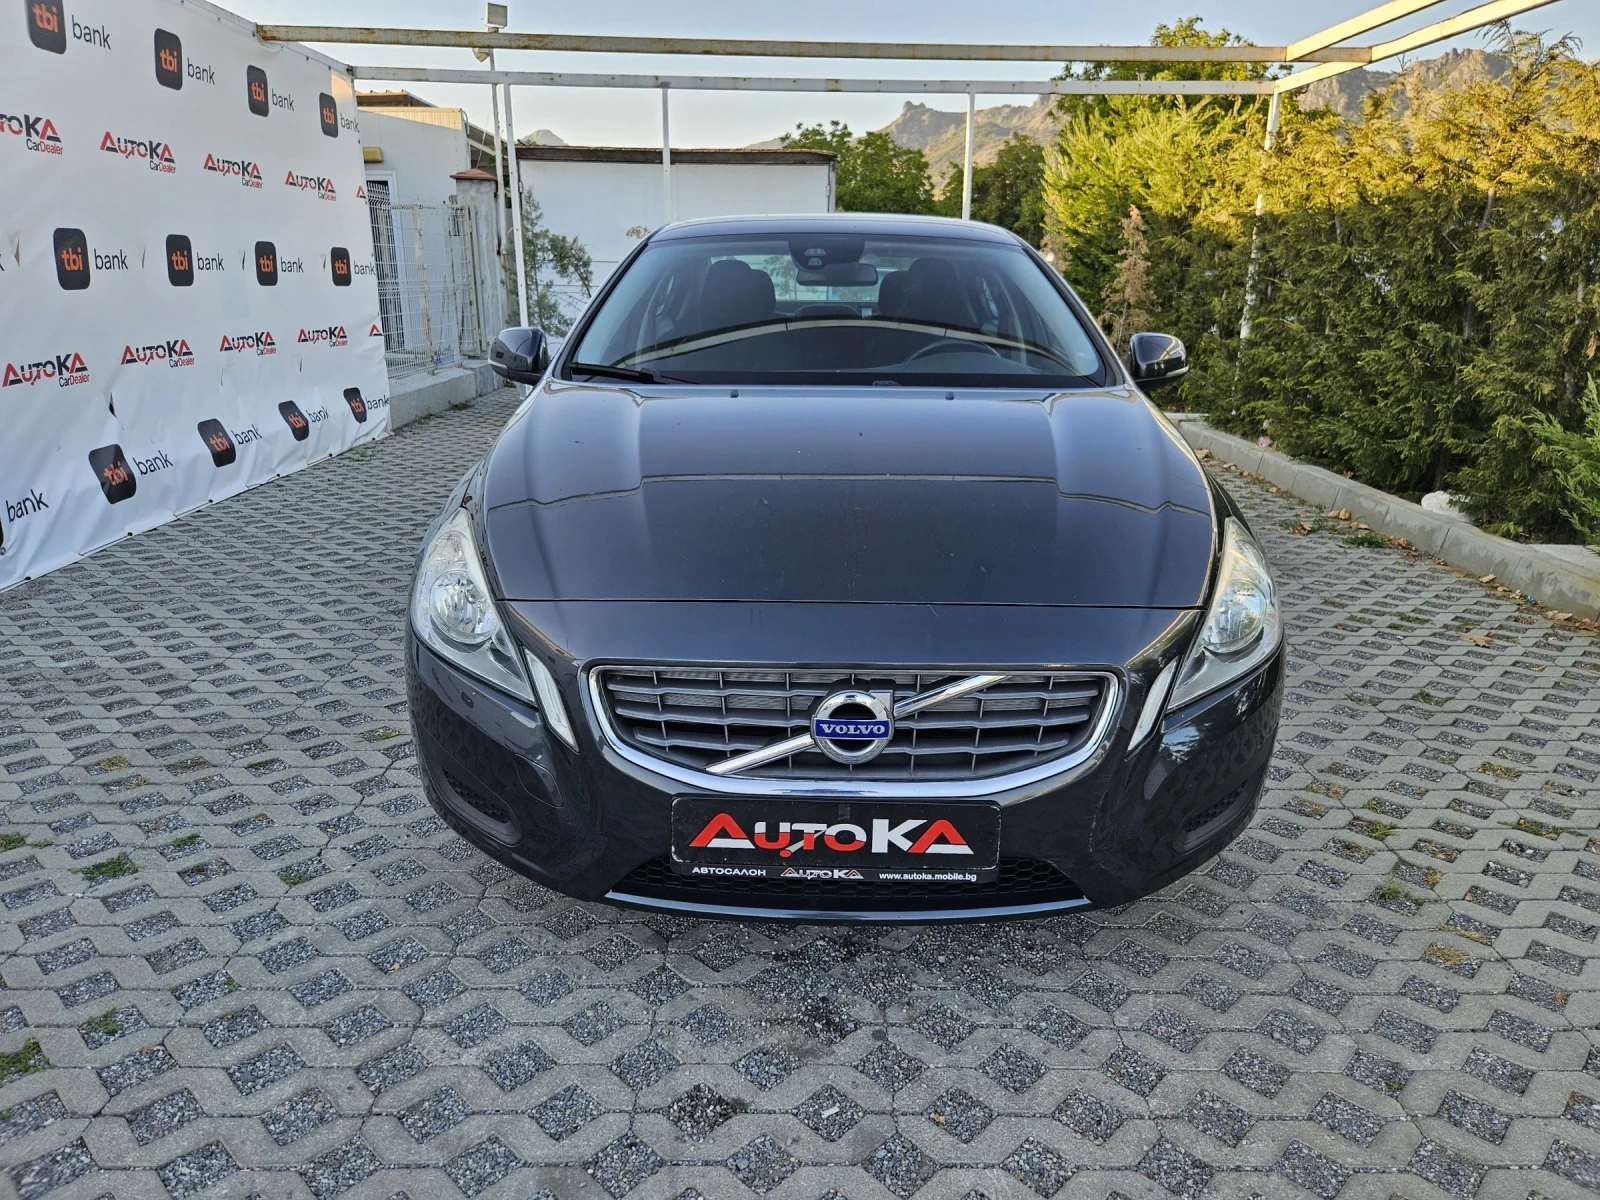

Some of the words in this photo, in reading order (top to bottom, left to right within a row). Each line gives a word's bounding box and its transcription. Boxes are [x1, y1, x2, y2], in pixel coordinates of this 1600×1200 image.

[32, 3, 59, 33] tbi
[71, 14, 112, 50] bank
[160, 49, 178, 73] tbi
[187, 57, 216, 85] bank
[251, 82, 265, 103] tbi
[272, 88, 295, 112] bank
[322, 107, 335, 125] tbi
[340, 112, 360, 133] bank
[26, 138, 63, 156] CarDealer
[100, 131, 176, 164] AUTOKA
[149, 161, 177, 174] CarDealer
[203, 153, 263, 181] AUTOKA
[241, 177, 264, 189] CarDealer
[285, 171, 336, 193] AUTOKA
[61, 247, 83, 271] tbi
[93, 248, 129, 271] bank
[171, 250, 189, 271] tbi
[196, 251, 225, 272] bank
[259, 255, 274, 273] tbi
[280, 256, 304, 273] bank
[334, 259, 348, 275] tbi
[353, 262, 377, 276] bank
[219, 331, 276, 353] AUTOKA
[297, 325, 348, 344] AUTOKA
[120, 339, 193, 366] AUTOKA
[256, 346, 277, 356] CarDealer
[2, 352, 89, 388] AUTOKA
[168, 356, 195, 369] CarDealer
[58, 373, 90, 388] CarDealer
[351, 397, 365, 413] tbi
[364, 394, 390, 411] bank
[286, 411, 306, 430] tbi
[305, 405, 331, 424] bank
[208, 431, 231, 452] tbi
[230, 423, 263, 446] bank
[103, 460, 129, 487] tbi
[132, 449, 174, 477] bank
[5, 488, 50, 524] bank
[819, 722, 886, 736] VOLVO
[689, 812, 975, 859] AUTOKA
[691, 866, 767, 877] АВТОСАЛОН
[780, 866, 865, 880] AUTOKA
[878, 872, 978, 883] www.autoka.mobile.bg
